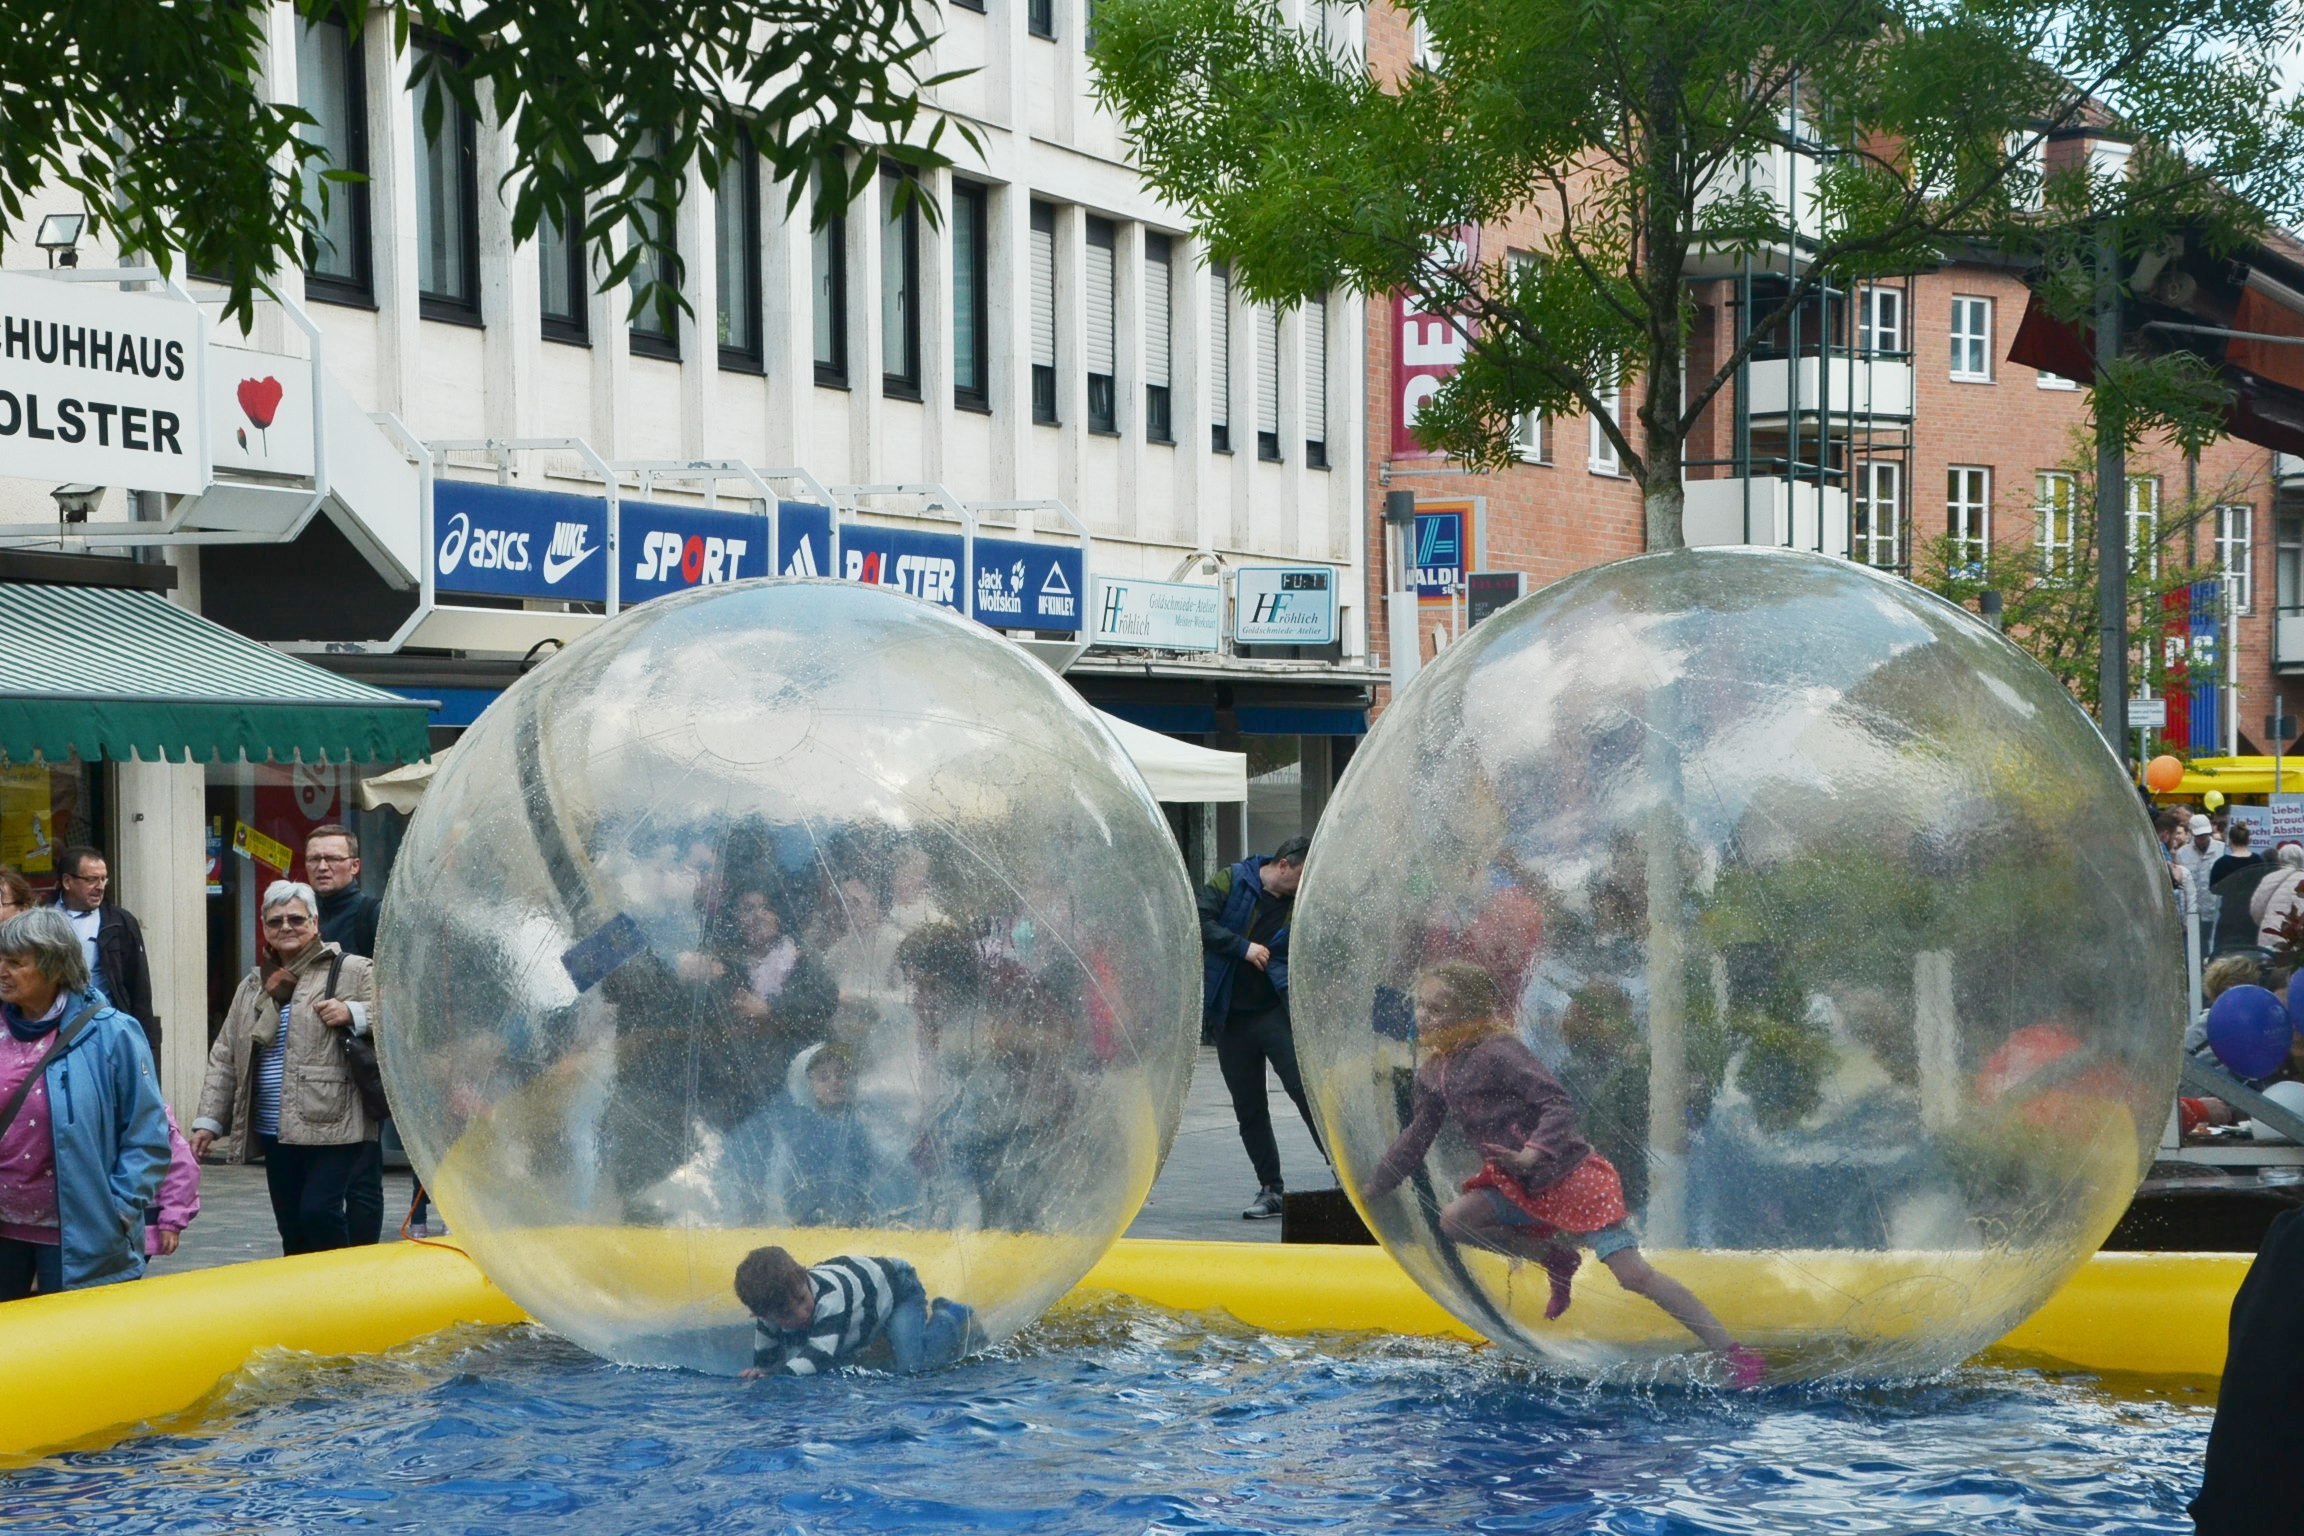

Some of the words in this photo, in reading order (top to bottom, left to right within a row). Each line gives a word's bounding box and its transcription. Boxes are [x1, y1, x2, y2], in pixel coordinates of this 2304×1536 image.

[0, 316, 184, 381] HUHHAUS
[469, 528, 530, 571] asics
[551, 522, 588, 556] NIKE
[635, 531, 747, 584] SPORT
[846, 550, 956, 602] POLSTER
[978, 567, 1003, 590] Jack
[1412, 567, 1459, 586] ALDI
[978, 589, 1022, 613] Wolfskin
